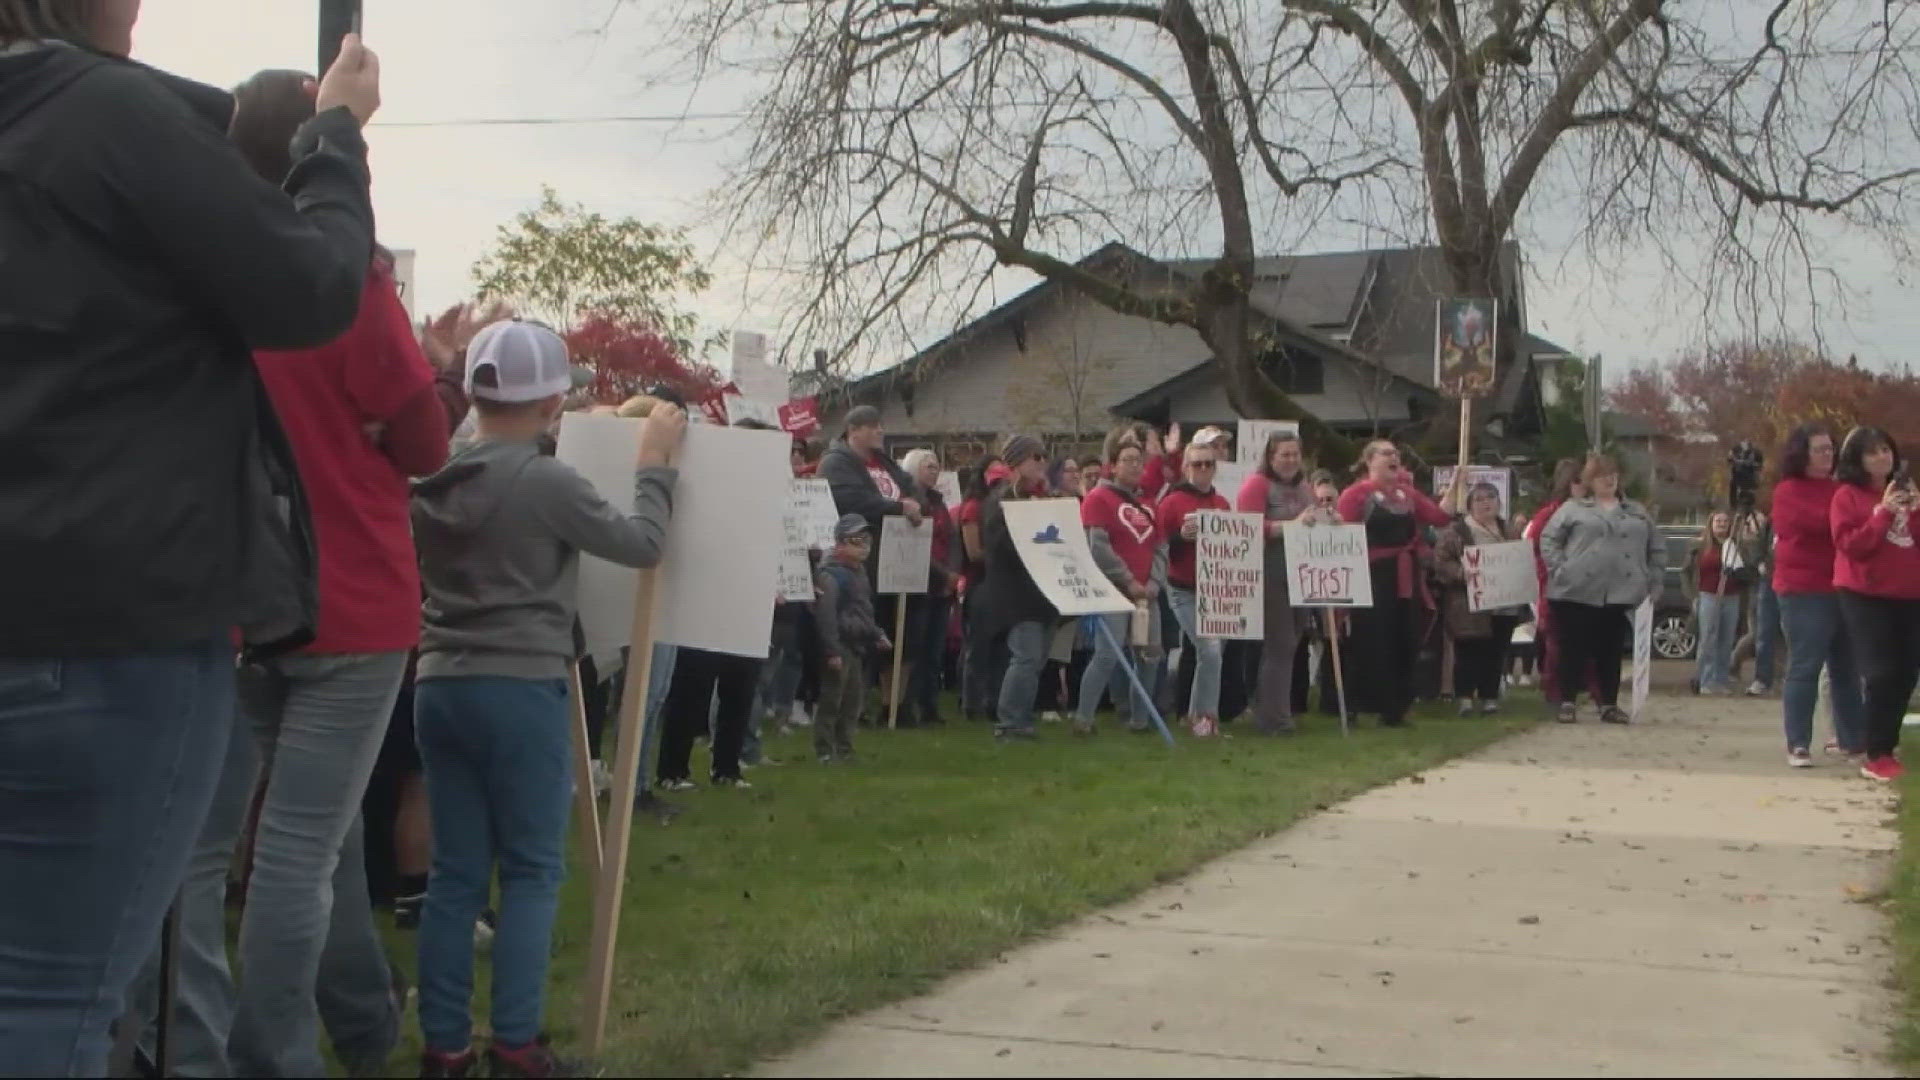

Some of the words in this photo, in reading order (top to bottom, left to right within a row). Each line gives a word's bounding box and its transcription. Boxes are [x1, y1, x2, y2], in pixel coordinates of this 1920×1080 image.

[1296, 531, 1363, 557] Students
[1237, 568, 1260, 583] our
[1298, 563, 1354, 599] FIRST
[1198, 597, 1210, 616] &
[1212, 598, 1243, 616] their
